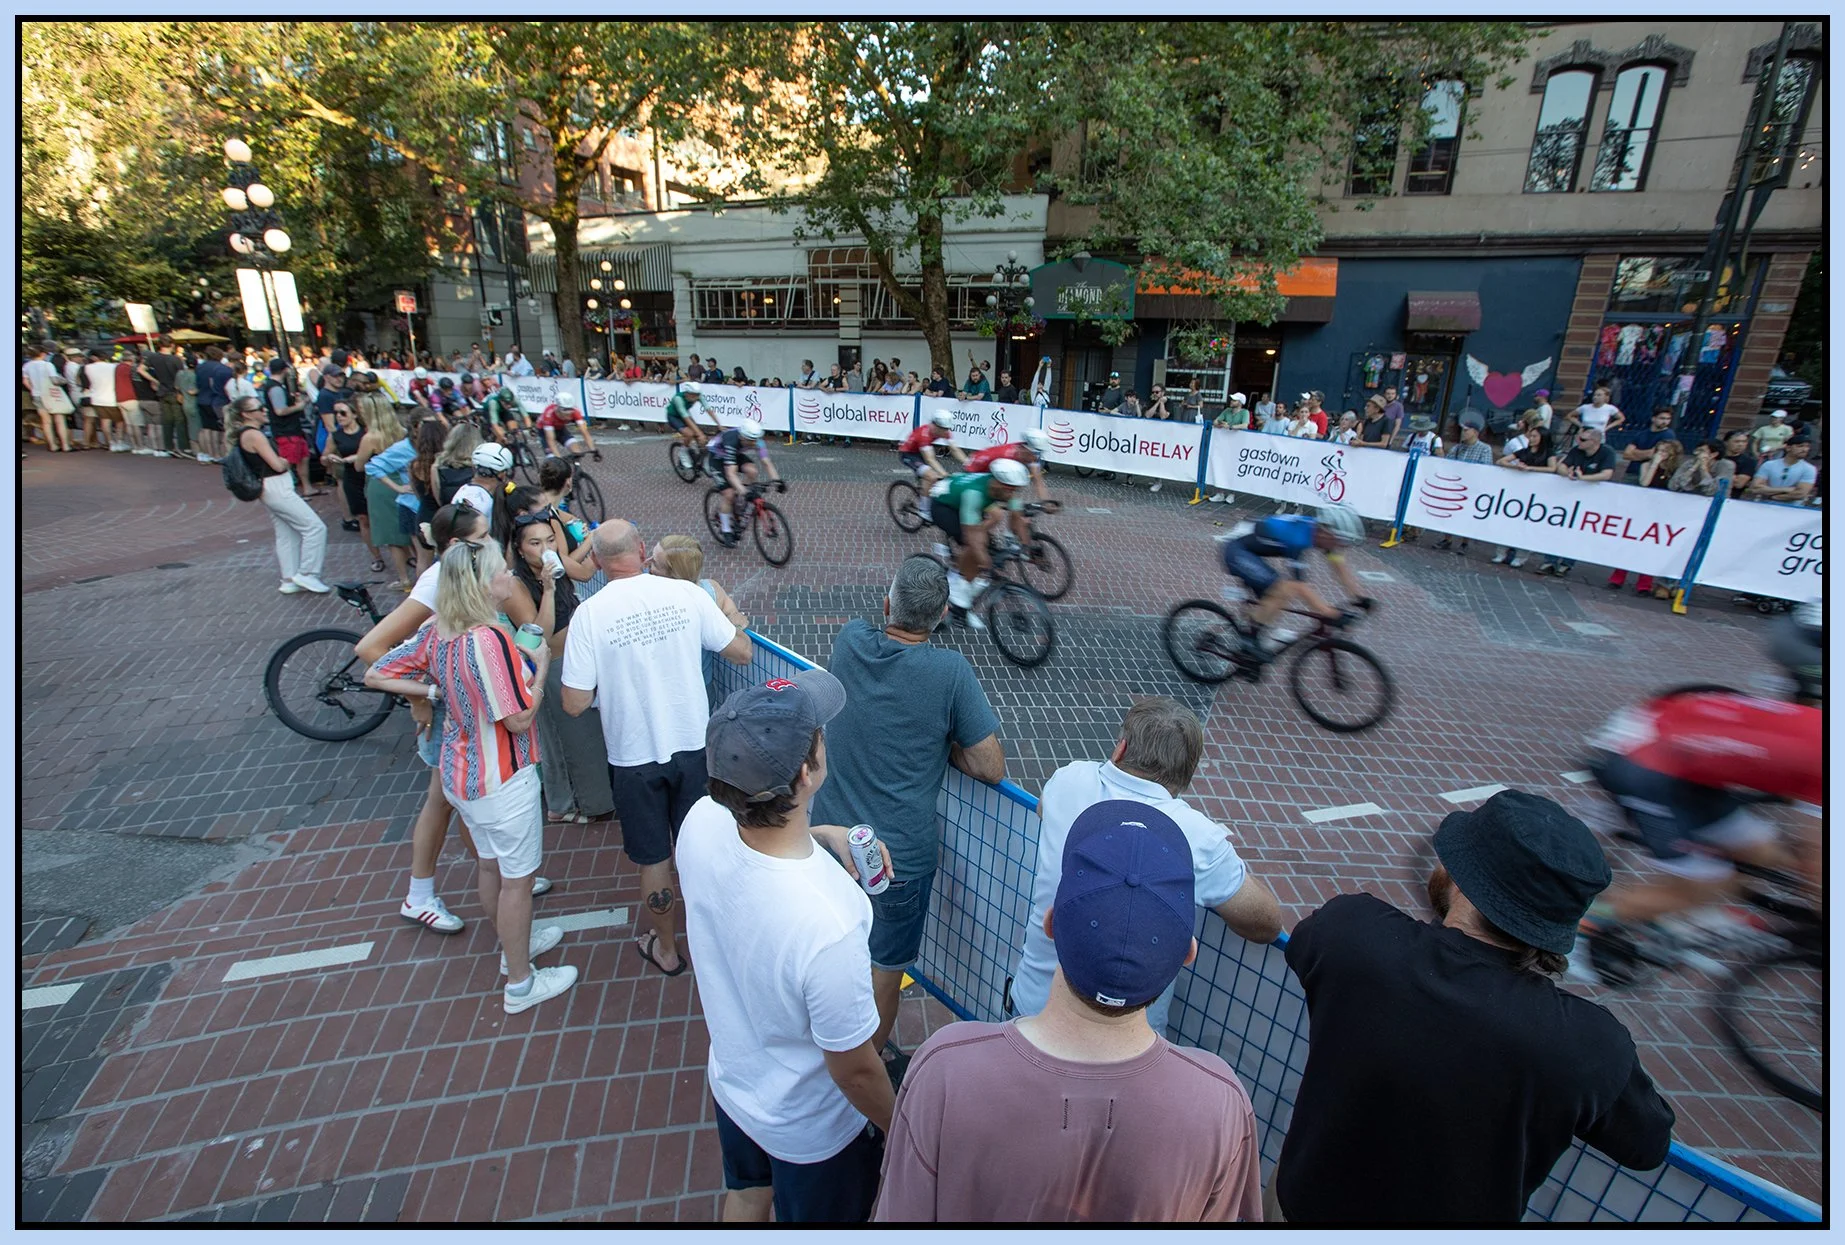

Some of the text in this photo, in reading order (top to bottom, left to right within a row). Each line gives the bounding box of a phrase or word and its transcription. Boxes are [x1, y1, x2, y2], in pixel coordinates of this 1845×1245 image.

[702, 394, 736, 404] astown
[727, 405, 742, 416] prix
[951, 410, 980, 422] stown
[968, 424, 987, 437] prix
[1238, 448, 1300, 467] gastown
[1237, 463, 1311, 486] grand prix
